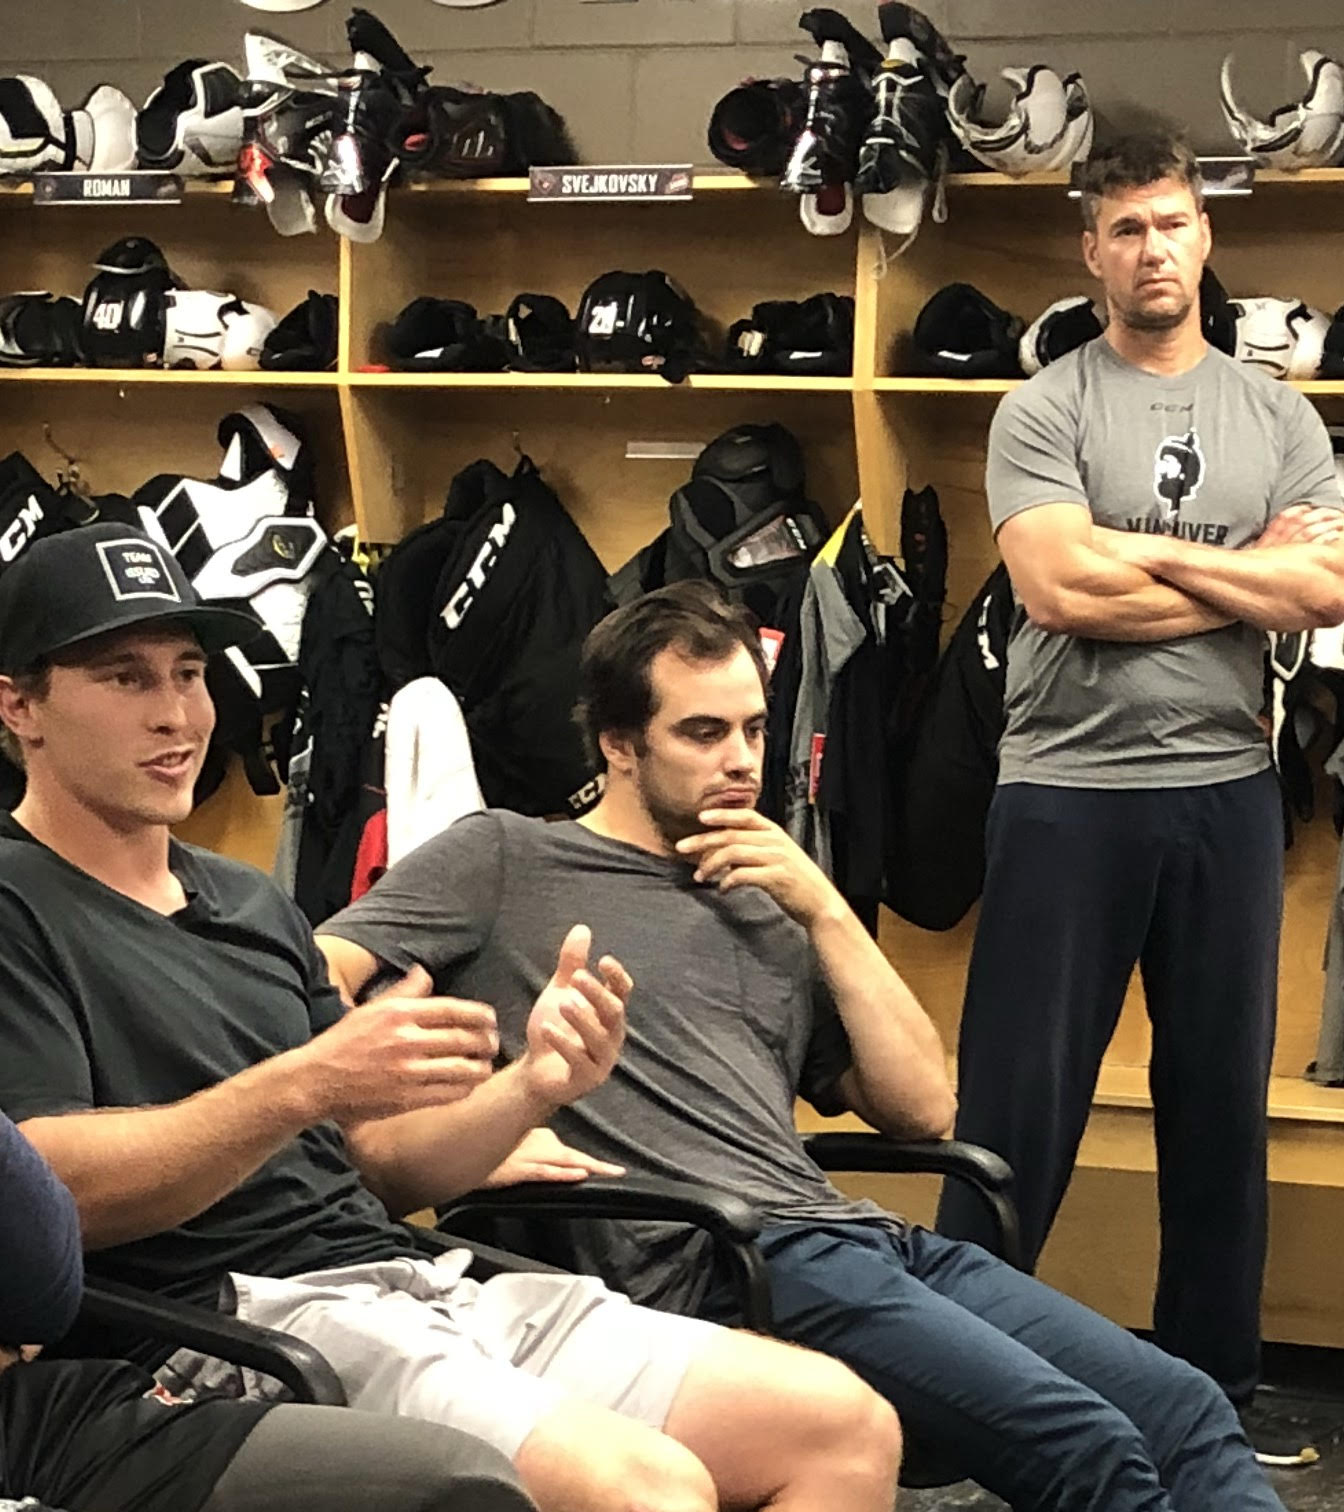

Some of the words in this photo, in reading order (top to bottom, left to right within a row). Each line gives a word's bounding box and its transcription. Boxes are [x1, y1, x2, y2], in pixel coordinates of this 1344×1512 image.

[83, 178, 131, 198] ROMAN
[561, 173, 658, 194] SVEJKOVSKY
[93, 301, 124, 330] 40
[439, 502, 517, 630] CCM
